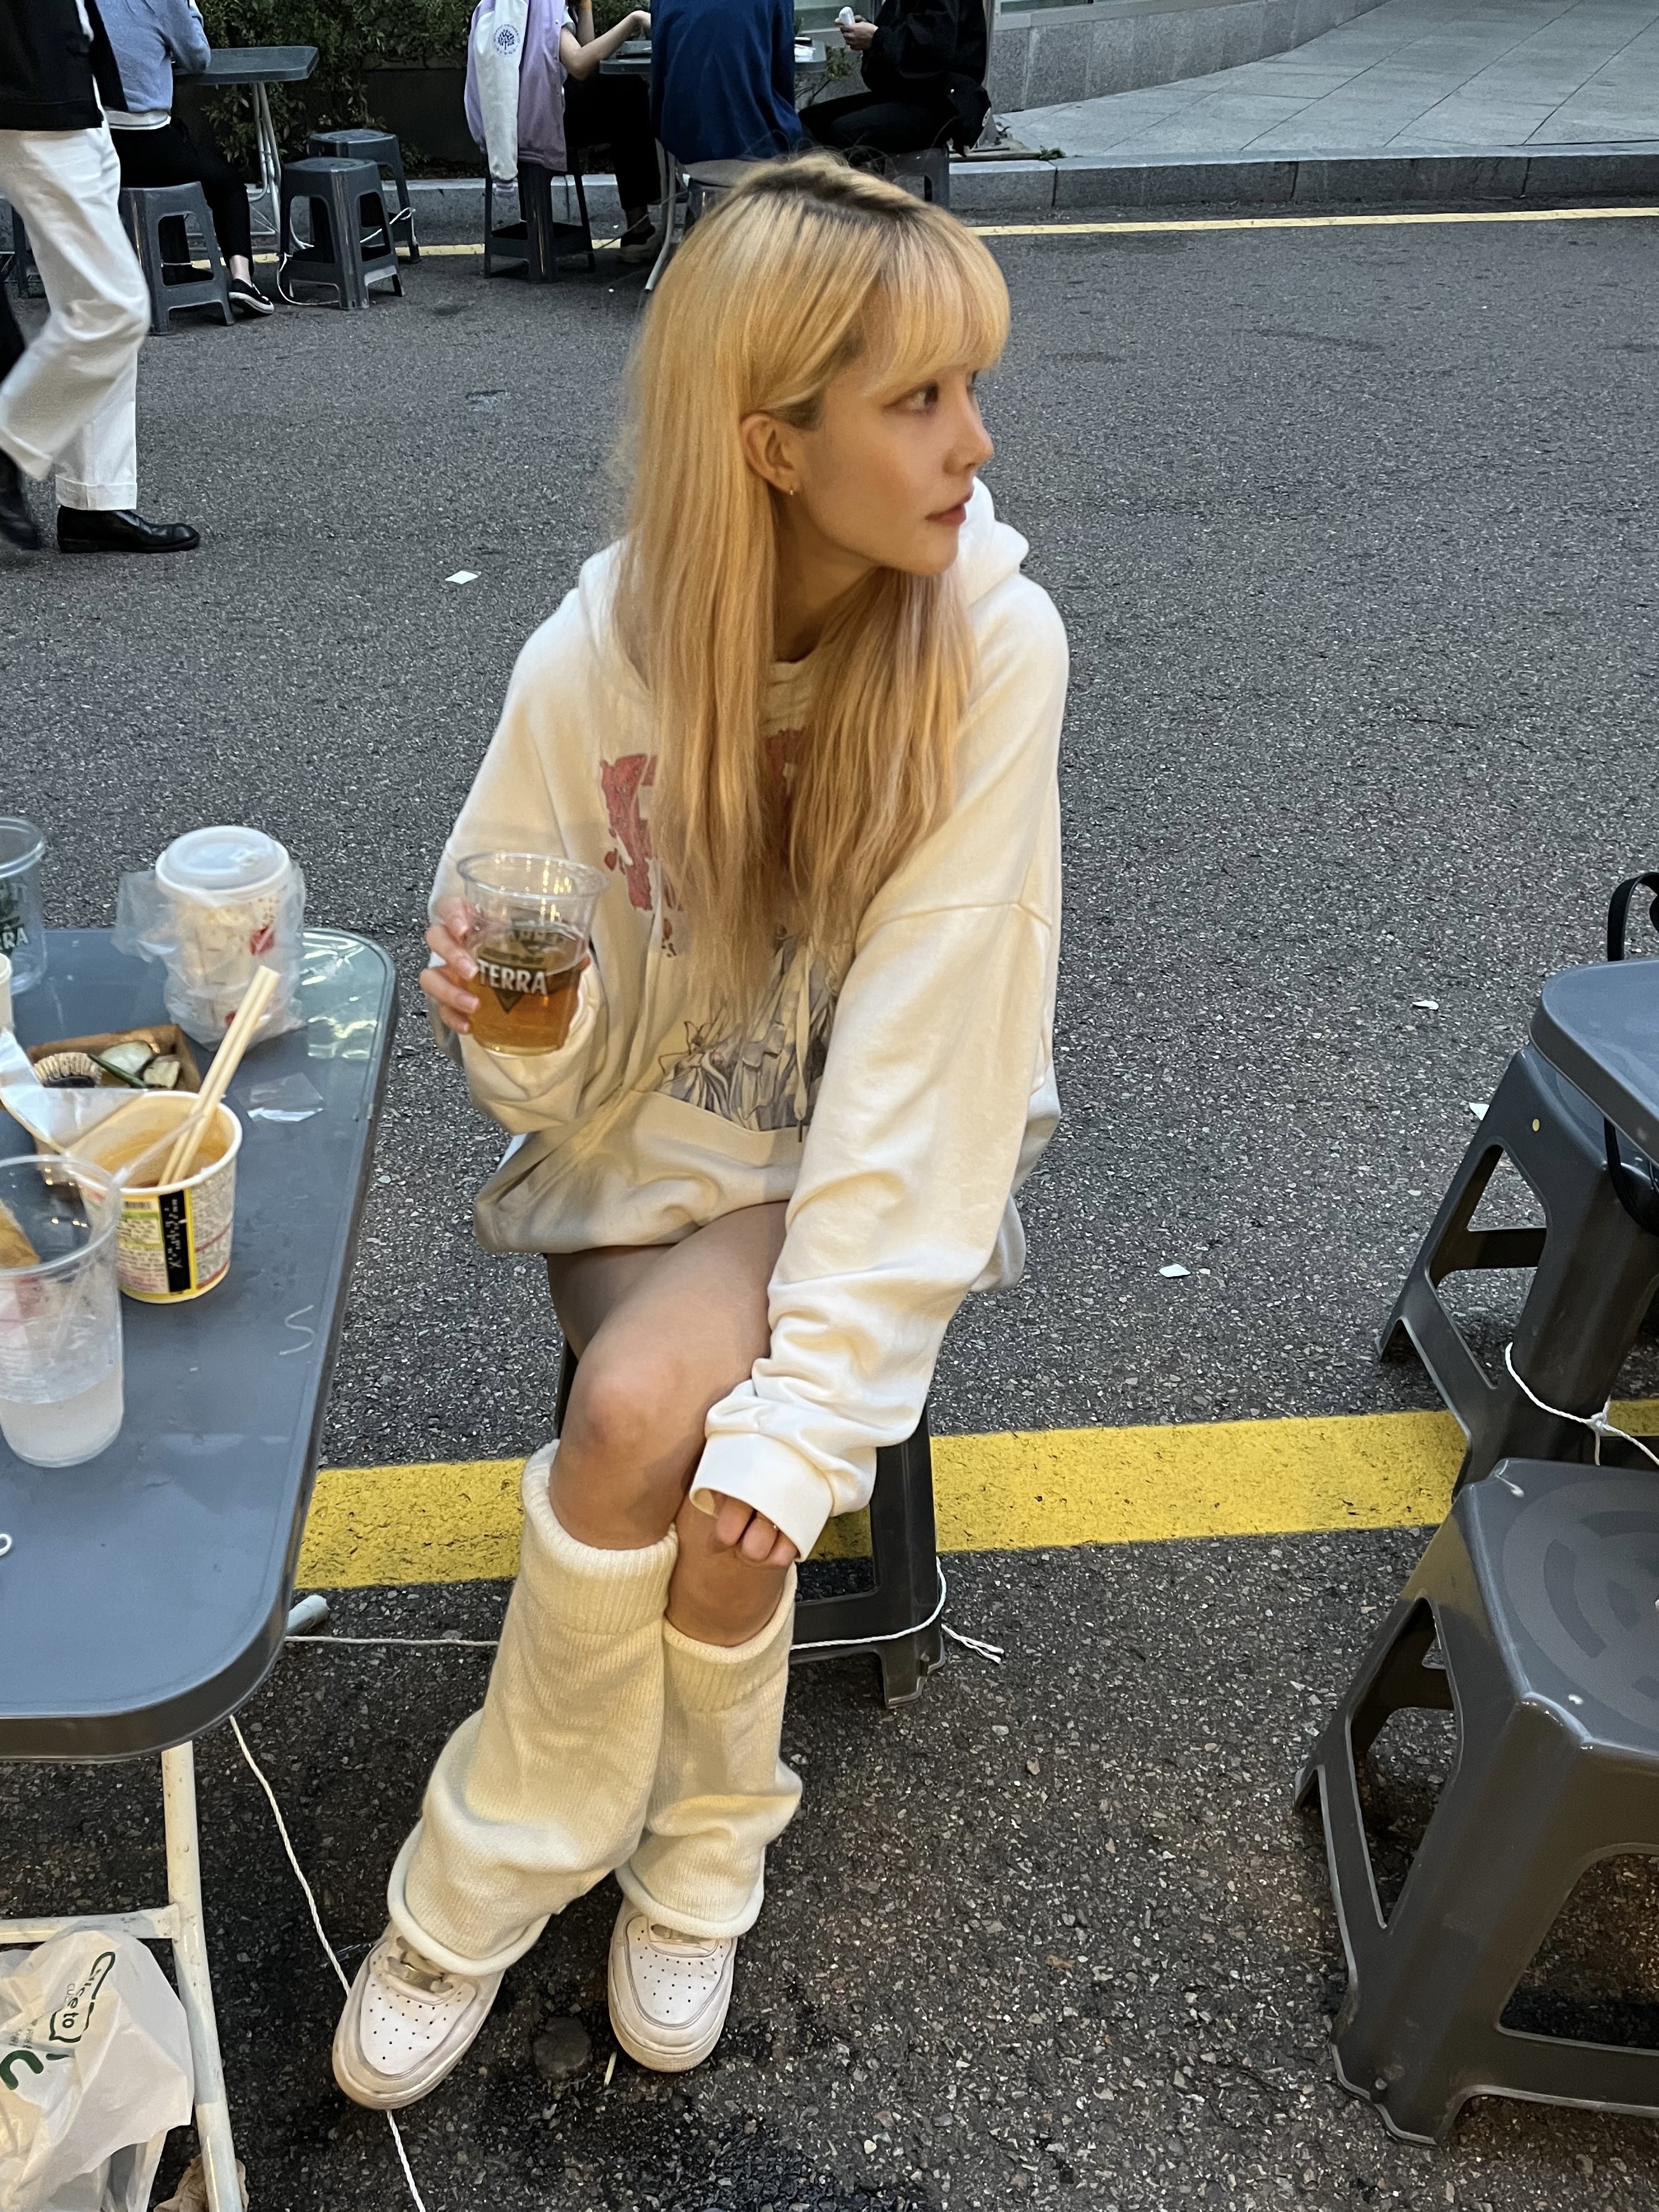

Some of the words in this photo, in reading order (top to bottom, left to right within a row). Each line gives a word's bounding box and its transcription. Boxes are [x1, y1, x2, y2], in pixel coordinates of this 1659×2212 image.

[0, 927, 29, 950] RA
[477, 958, 548, 996] TERRA
[62, 2012, 80, 2029] to
